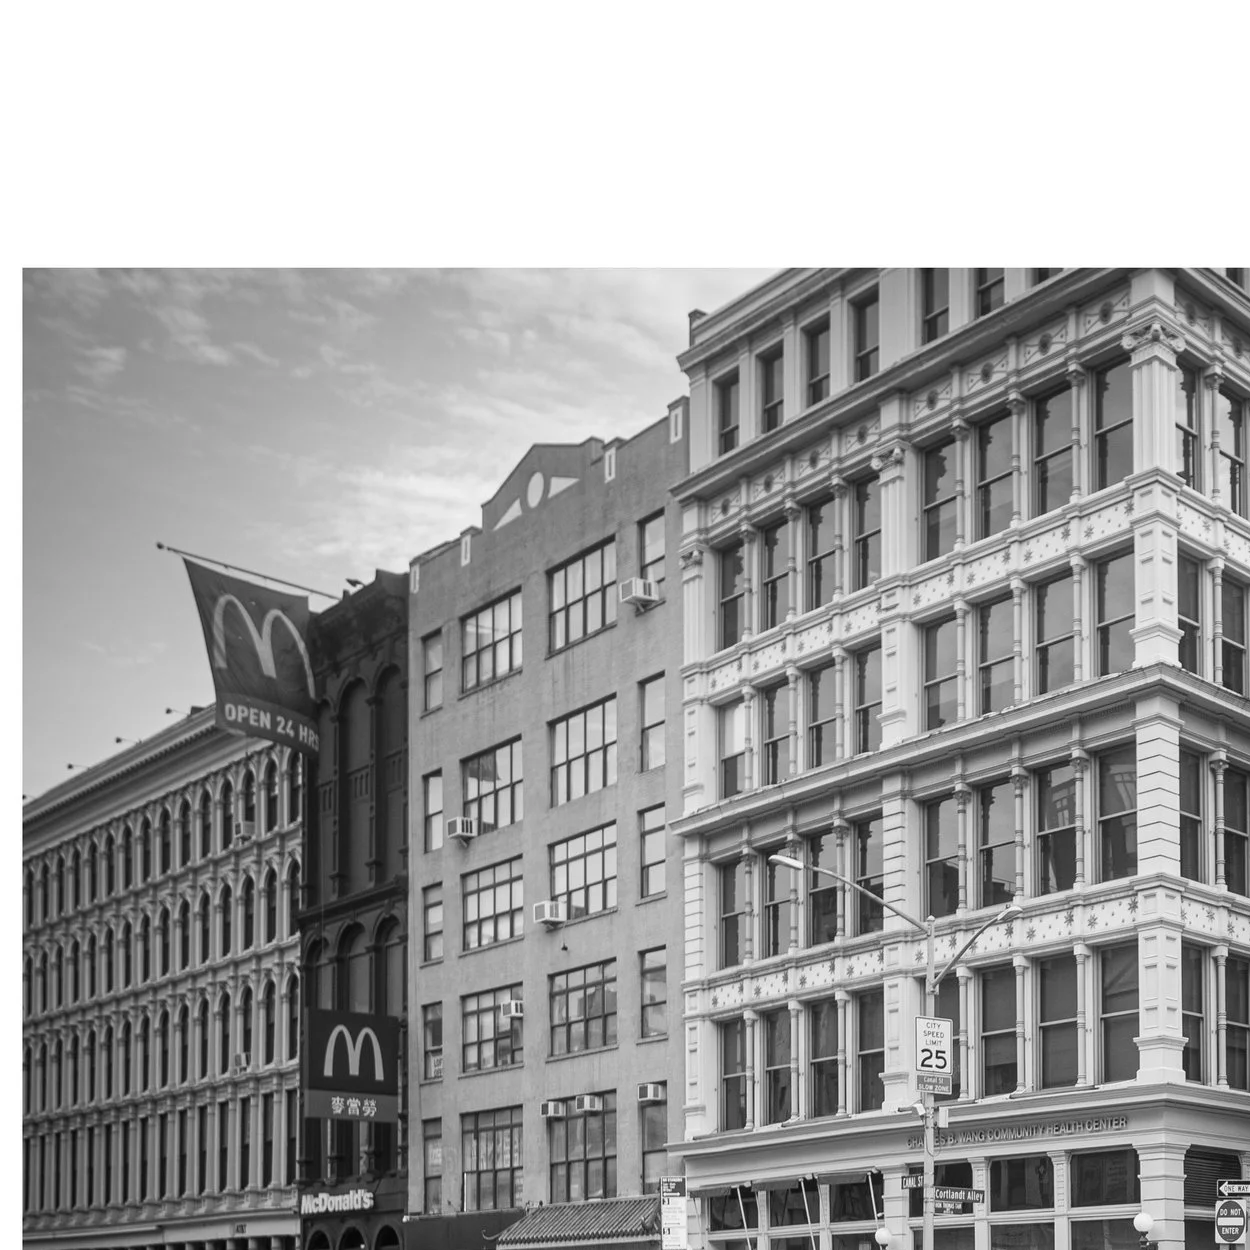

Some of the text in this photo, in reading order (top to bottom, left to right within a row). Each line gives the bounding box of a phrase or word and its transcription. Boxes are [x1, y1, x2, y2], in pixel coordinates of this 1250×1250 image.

[224, 703, 320, 752] OPEN 24 HRS
[923, 1030, 945, 1038] SPEED
[925, 1039, 943, 1047] LIMIT
[920, 1048, 947, 1069] 25
[331, 1096, 377, 1117] 麥當勞
[907, 1117, 1128, 1149] CHAES B. WANG COMMUNITY HEALTH CENTER
[902, 1175, 923, 1188] CANAL ST
[935, 1189, 984, 1202] Cortlandt Alley
[1224, 1185, 1235, 1193] ONE
[301, 1189, 373, 1214] McDonald's
[1220, 1208, 1241, 1216] DO NOT
[1222, 1227, 1239, 1235] ENTER
